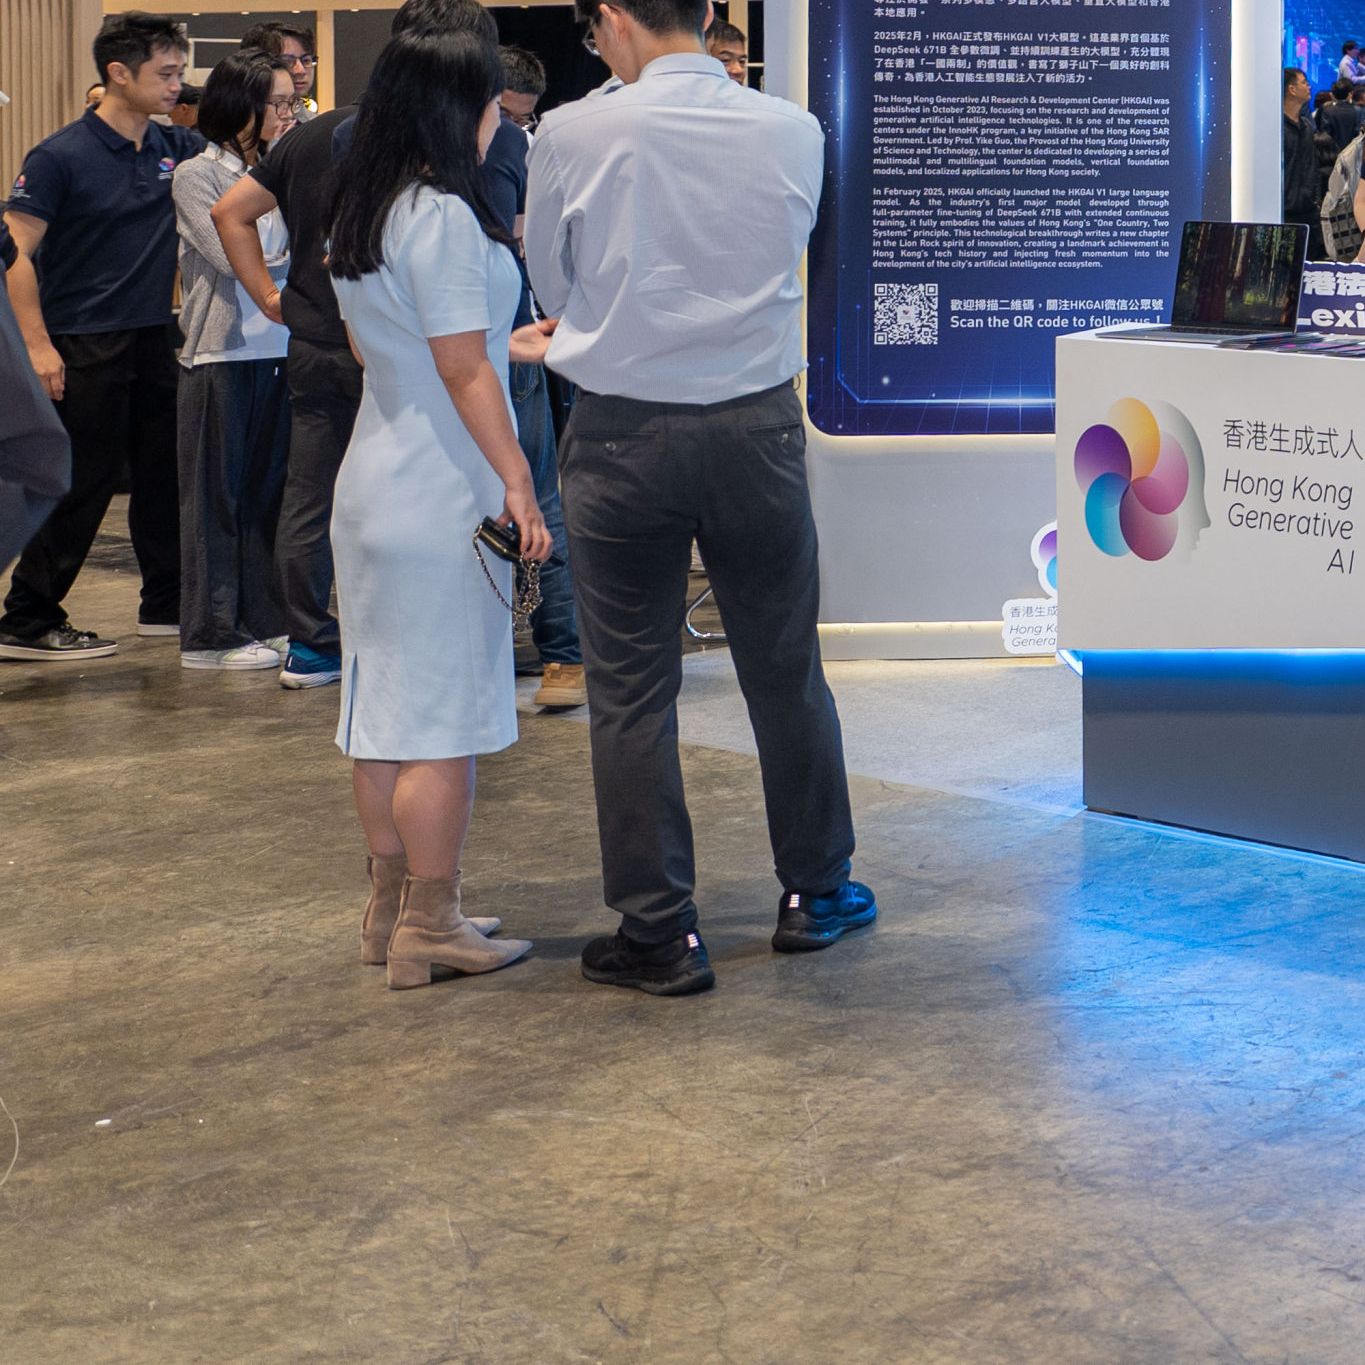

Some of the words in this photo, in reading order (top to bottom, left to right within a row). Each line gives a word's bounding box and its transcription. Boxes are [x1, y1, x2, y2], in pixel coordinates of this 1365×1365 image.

[873, 45, 921, 57] DeepSeek
[923, 45, 947, 56] 671B
[874, 95, 889, 104] The
[891, 95, 911, 106] Hong
[914, 95, 934, 106] Kong
[936, 95, 979, 104] Generative
[981, 95, 989, 104] AI
[991, 95, 1028, 104] Research
[1030, 95, 1036, 104] &
[1039, 95, 1090, 106] Development
[1092, 95, 1119, 104] Center
[1121, 95, 1152, 106] (HKGAI)
[873, 198, 900, 206] model.
[910, 198, 920, 206] As
[929, 198, 941, 206] the
[950, 198, 990, 208] industry's
[998, 198, 1015, 206] first
[1024, 200, 1047, 208] major
[1056, 198, 1081, 206] model
[1089, 198, 1129, 208] developed
[1138, 198, 1169, 208] through
[950, 315, 985, 328] Scan
[988, 315, 1010, 328] the
[1013, 315, 1033, 328] QR
[1037, 315, 1067, 328] code
[1071, 316, 1086, 328] to
[1223, 468, 1284, 503] Hong
[1291, 475, 1353, 510] Kong
[1227, 503, 1354, 540] Generative
[1327, 548, 1355, 574] AI
[1010, 625, 1042, 636] Hong
